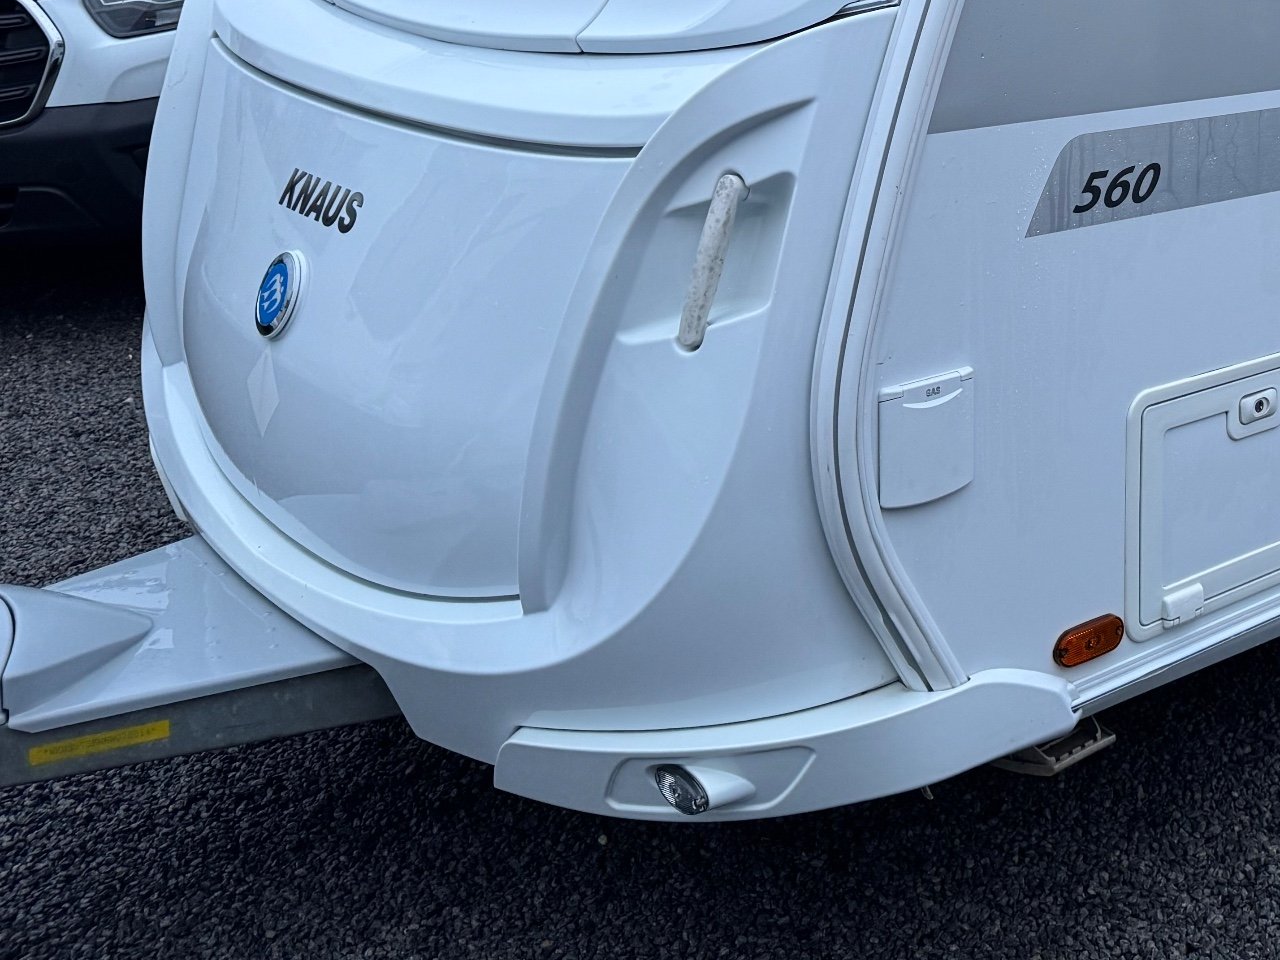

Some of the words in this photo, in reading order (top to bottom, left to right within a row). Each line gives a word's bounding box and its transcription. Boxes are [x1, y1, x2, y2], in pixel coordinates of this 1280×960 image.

[278, 167, 365, 234] KNAUS
[1072, 162, 1162, 214] 560
[925, 386, 941, 397] GAS
